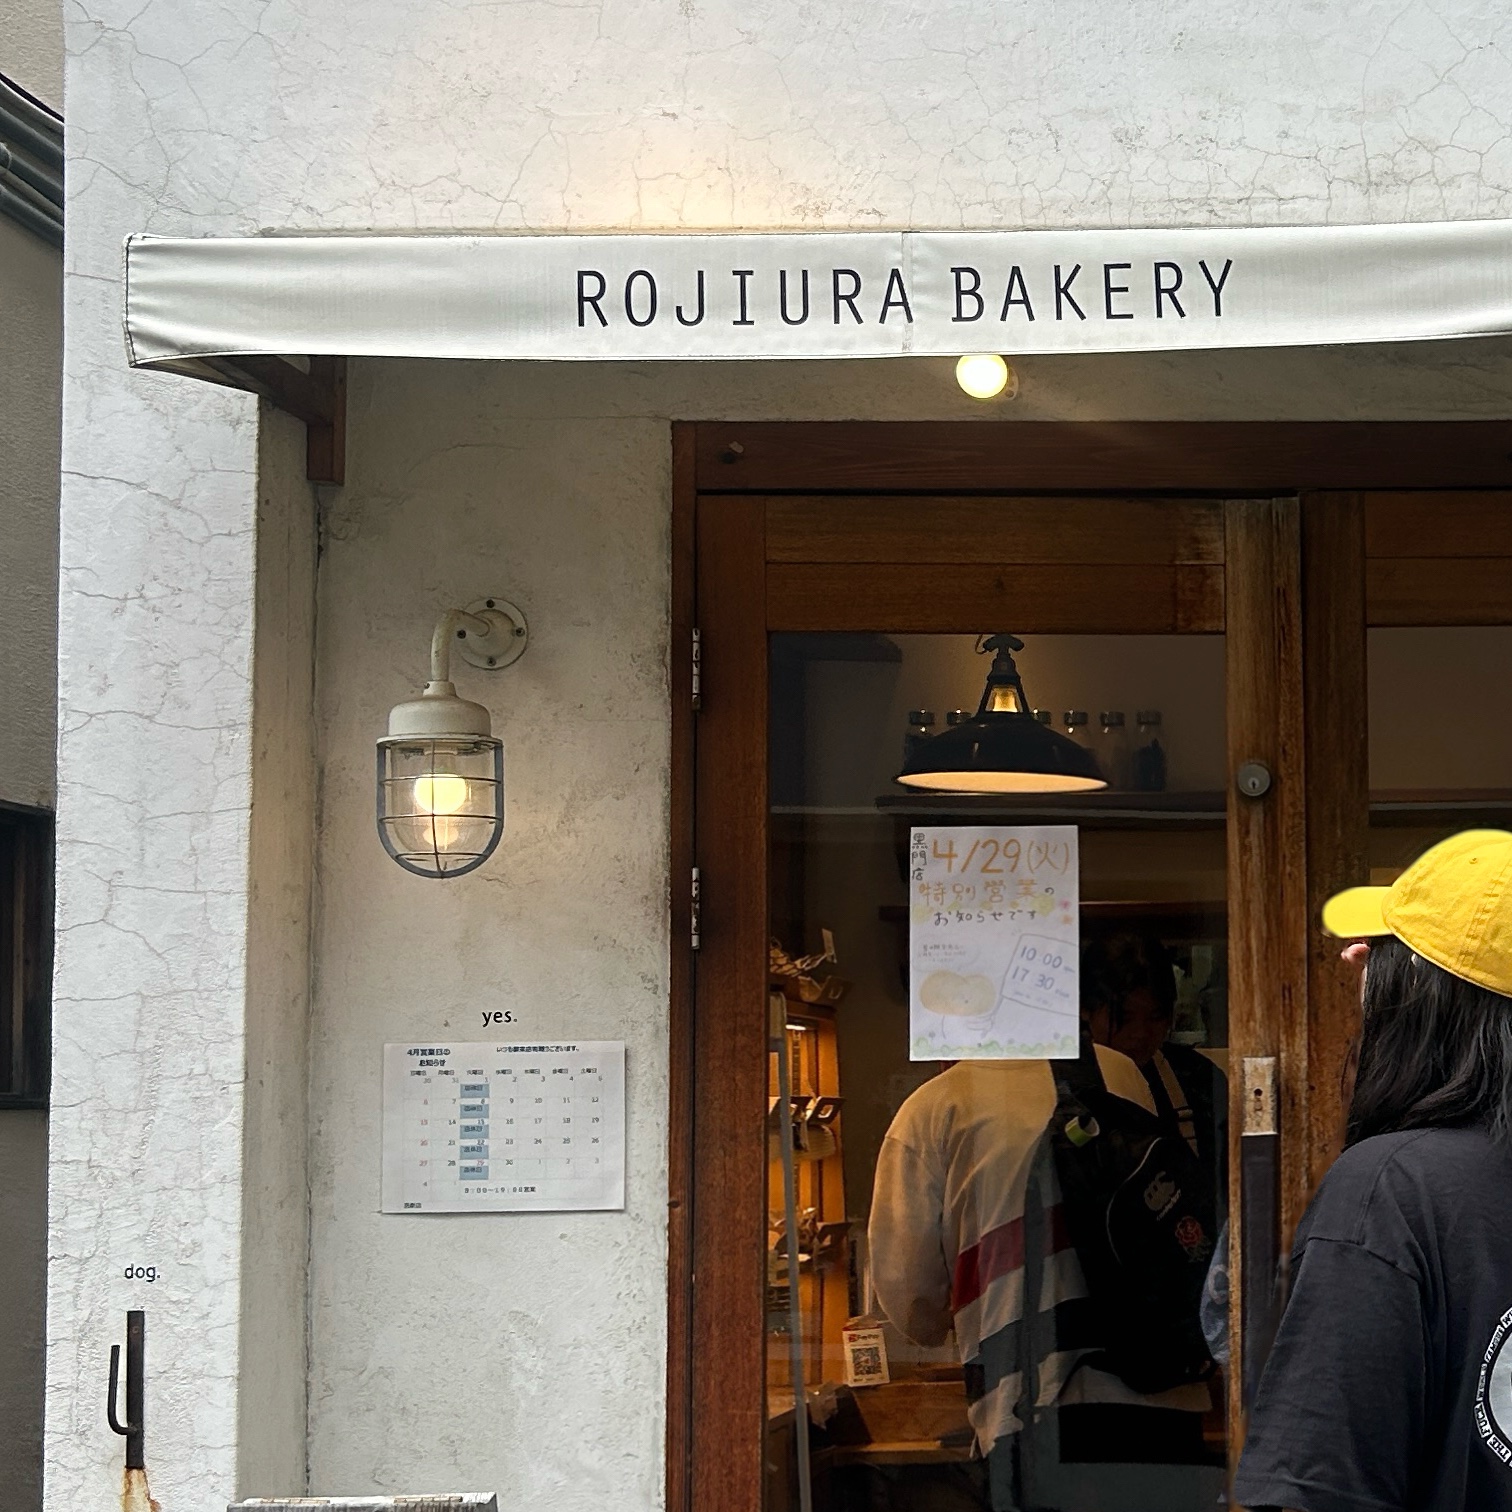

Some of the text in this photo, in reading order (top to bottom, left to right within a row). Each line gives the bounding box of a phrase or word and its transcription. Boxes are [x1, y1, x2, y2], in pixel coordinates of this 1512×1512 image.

[577, 259, 1233, 327] ROJIURA BAKERY
[934, 909, 1037, 926] お知らせです
[482, 1010, 518, 1028] yes.
[124, 1263, 161, 1283] dog.
